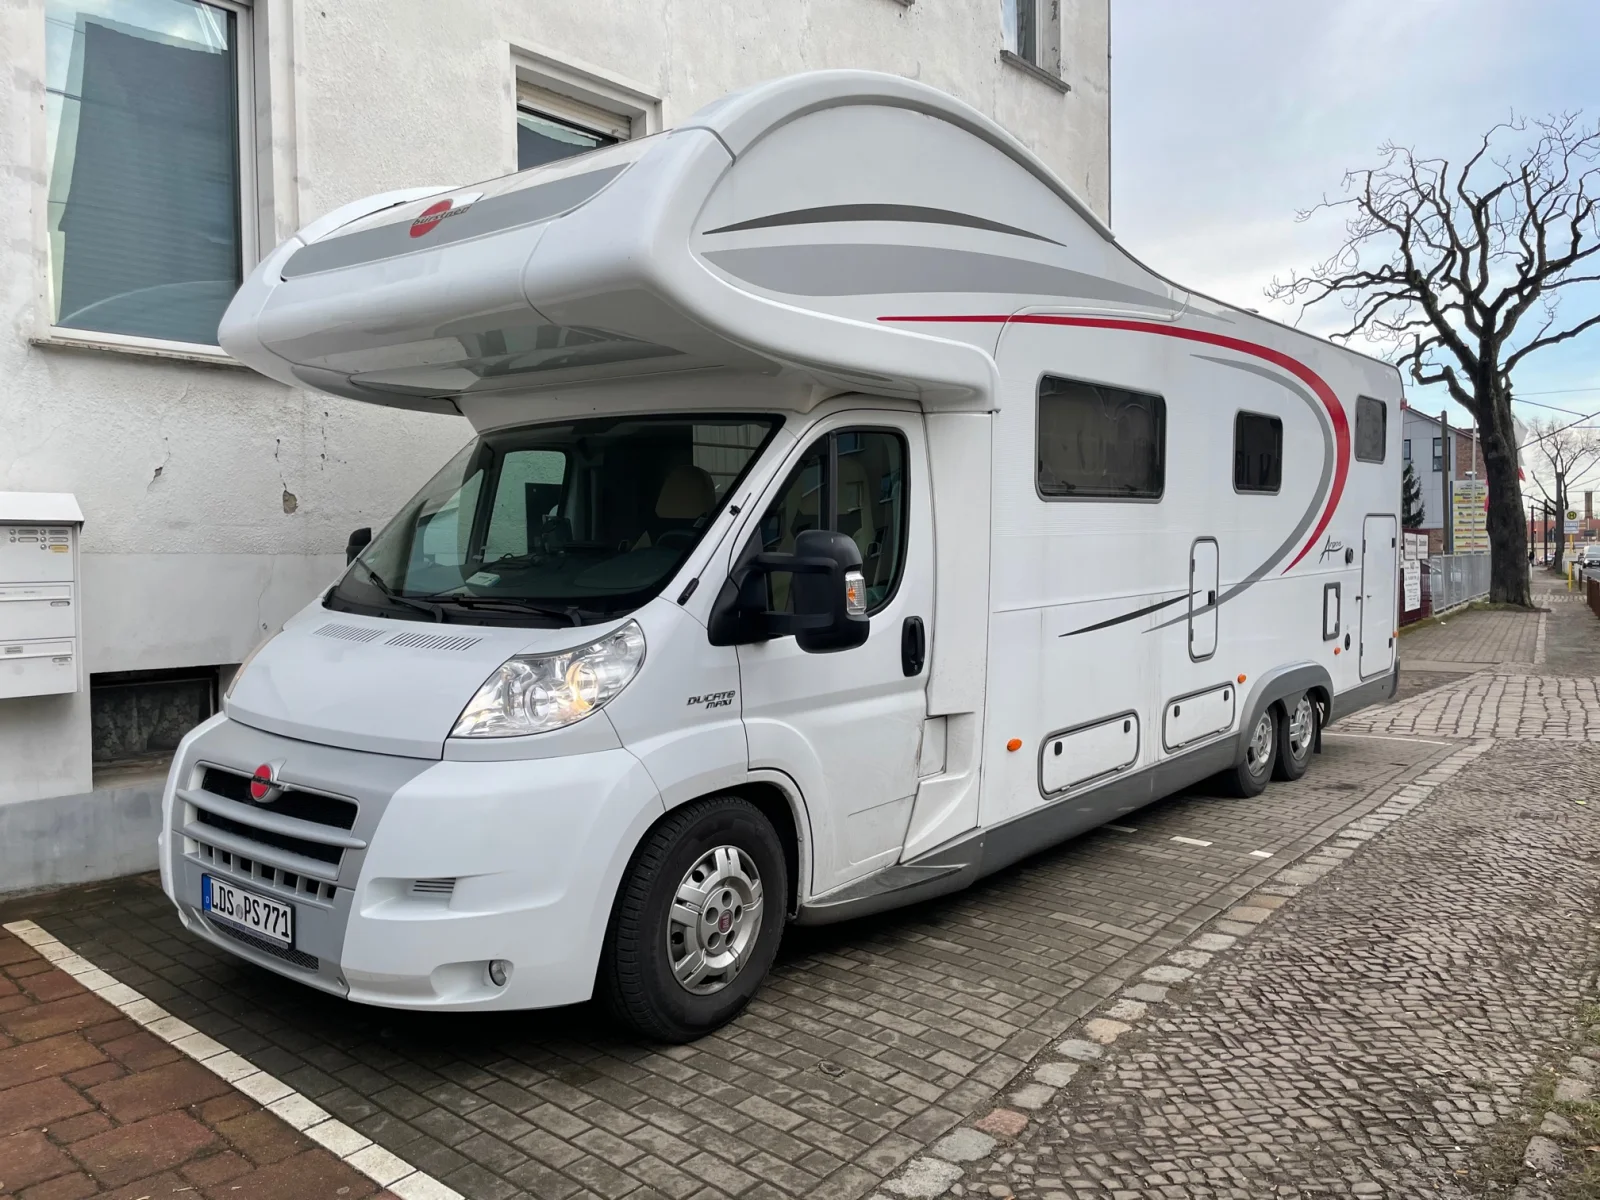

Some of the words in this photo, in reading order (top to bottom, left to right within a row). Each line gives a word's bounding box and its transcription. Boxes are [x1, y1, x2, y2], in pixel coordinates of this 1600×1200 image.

[686, 690, 736, 706] DUCATO
[705, 698, 733, 710] MAXI
[211, 882, 234, 916] LDS
